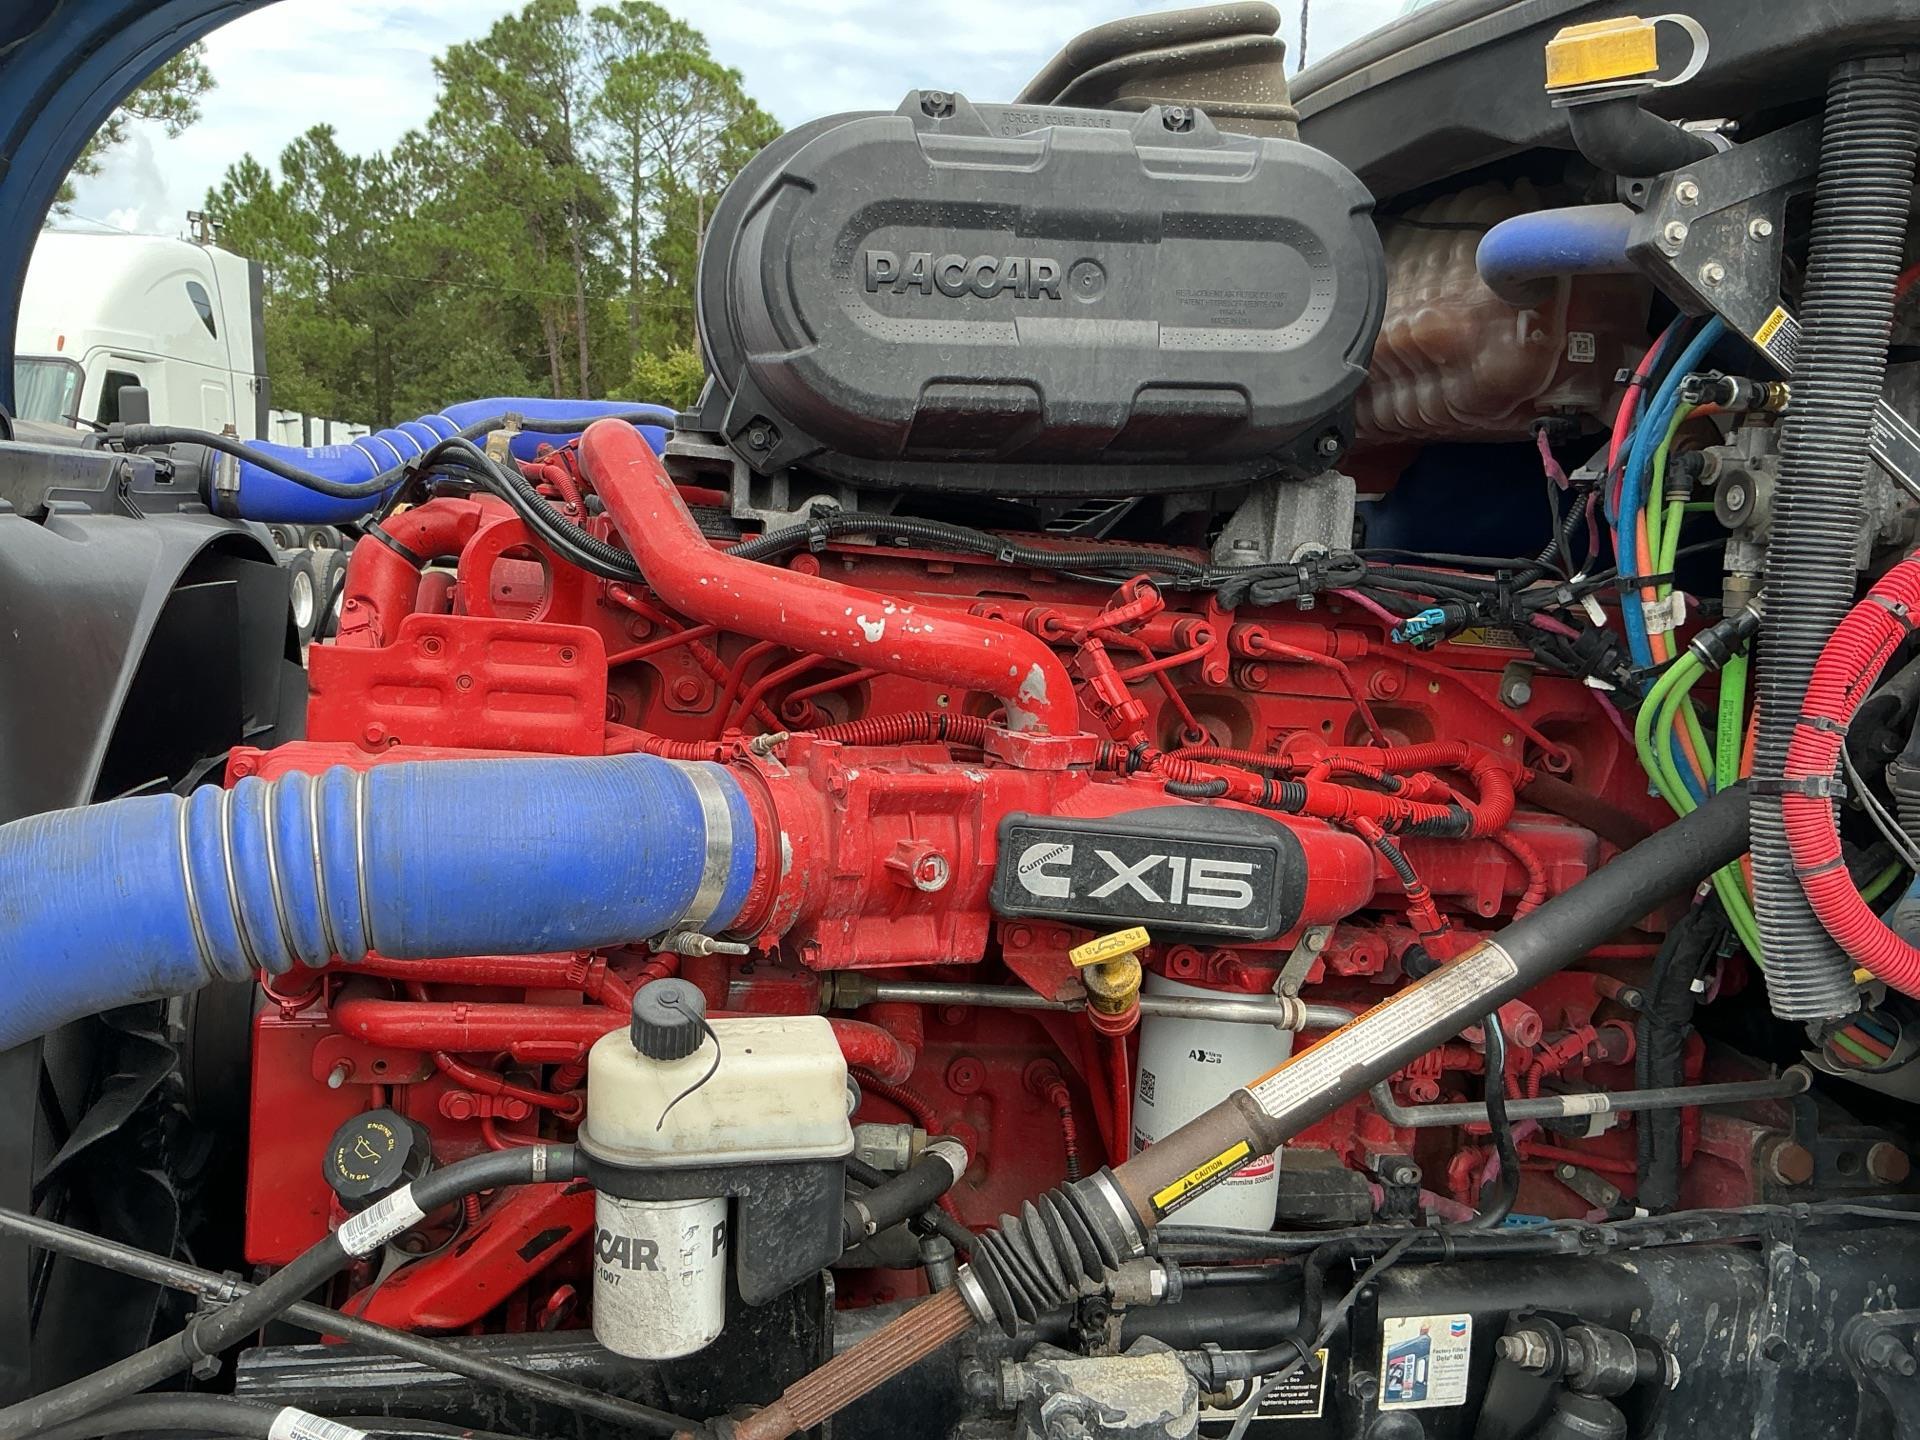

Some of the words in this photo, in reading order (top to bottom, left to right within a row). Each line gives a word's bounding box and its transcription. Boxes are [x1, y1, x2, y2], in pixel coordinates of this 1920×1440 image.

[1002, 112, 1039, 124] TORQUE
[1044, 115, 1075, 126] COVER
[1082, 118, 1111, 128] BOLTS
[866, 250, 1062, 299] PACCAR
[1759, 313, 1785, 342] CAUTION
[1019, 844, 1070, 874] Cummins
[1346, 994, 1399, 1028] WARNING
[1188, 1050, 1197, 1059] A
[367, 1123, 393, 1138] ENGINE
[339, 1164, 348, 1176] FILL
[1194, 1159, 1223, 1180] CAUTION
[1221, 1178, 1253, 1187] Cummins
[595, 1223, 659, 1271] CAR
[594, 1262, 622, 1286] -1007
[1261, 1399, 1287, 1407] tightening
[1280, 1391, 1298, 1399] torque
